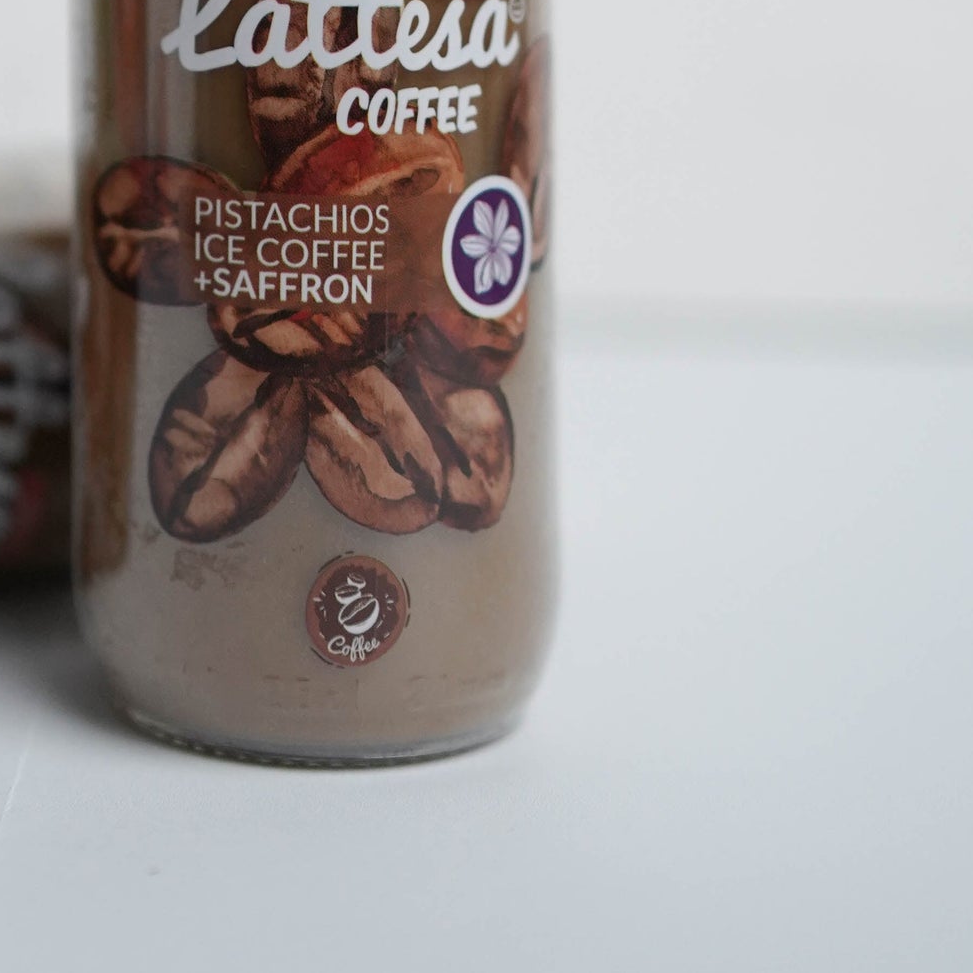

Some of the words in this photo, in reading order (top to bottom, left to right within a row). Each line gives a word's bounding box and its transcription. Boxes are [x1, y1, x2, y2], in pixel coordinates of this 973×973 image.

[336, 83, 482, 136] COFFEE
[194, 196, 391, 235] PISTACHIOS
[194, 232, 246, 266] ICE
[256, 237, 385, 271] COFFEE
[193, 269, 374, 305] +SAFFRON
[327, 635, 381, 663] Coffee
